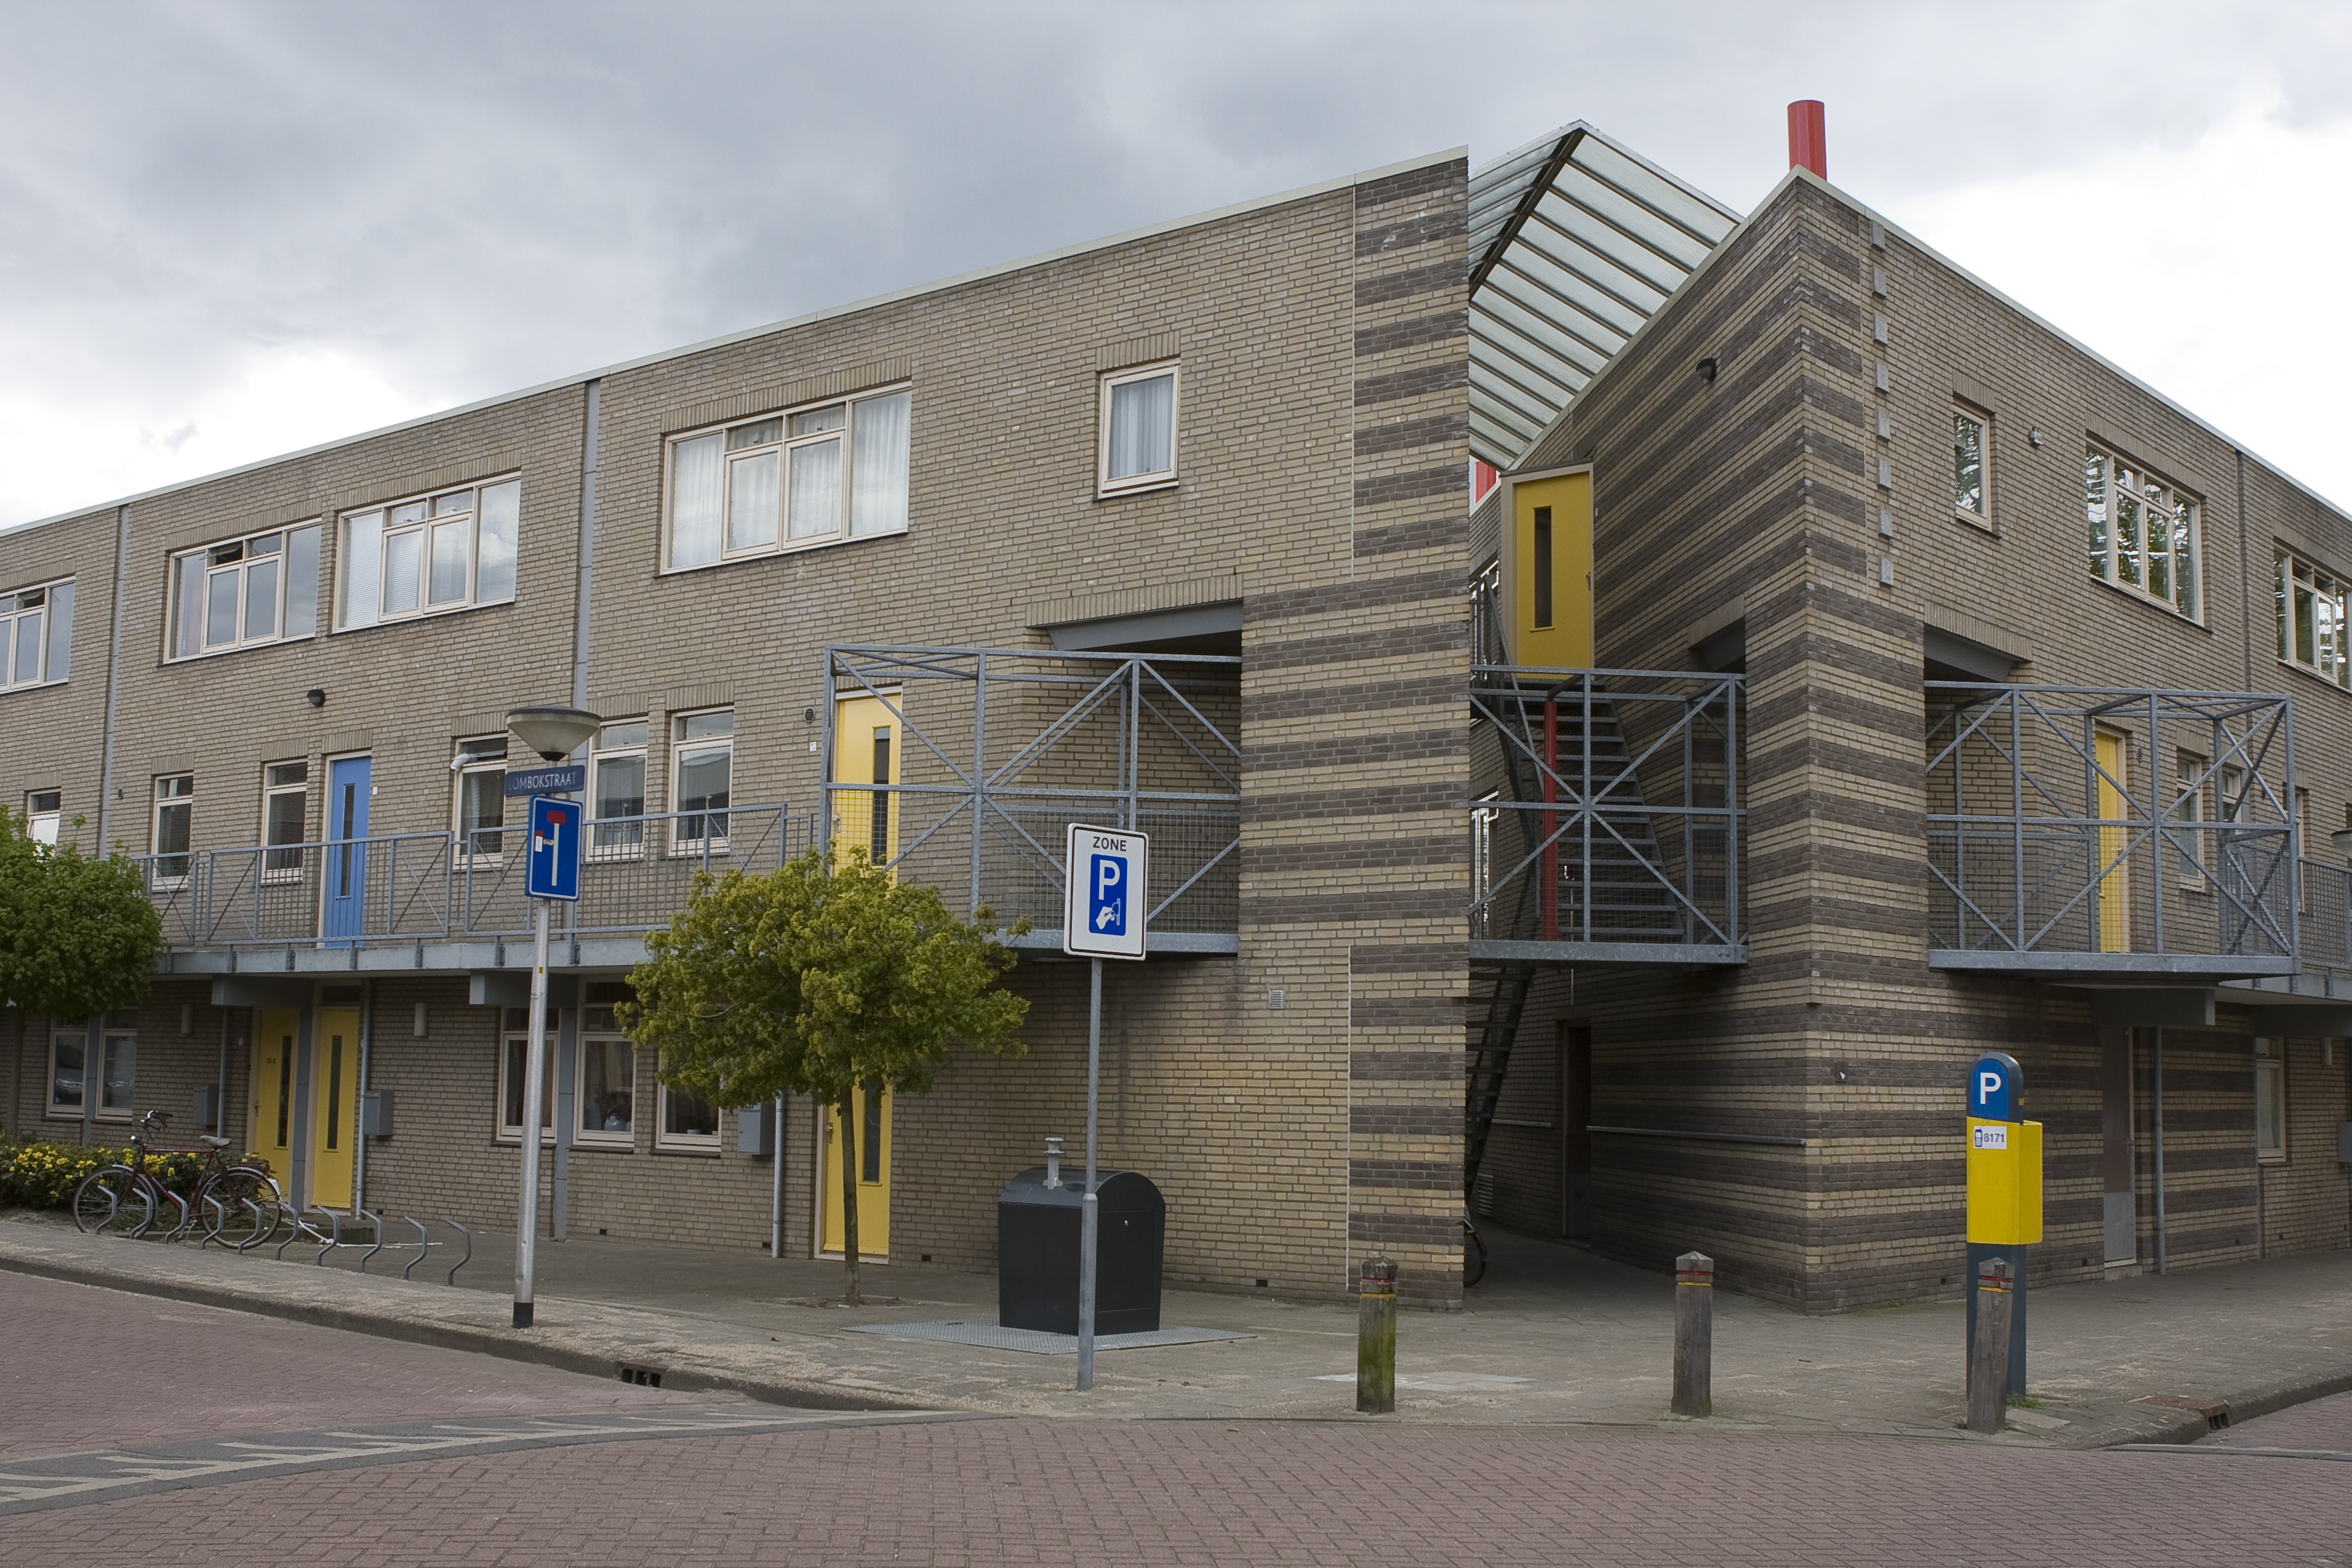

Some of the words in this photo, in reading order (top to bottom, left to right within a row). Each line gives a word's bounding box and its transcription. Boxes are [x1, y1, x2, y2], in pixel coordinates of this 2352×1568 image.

[508, 772, 578, 791] LOMBOKSTRAAT
[1093, 836, 1127, 852] ZONE
[1099, 859, 1120, 900] P
[1980, 1072, 2001, 1105] P
[1984, 1133, 2004, 1143] 8171
